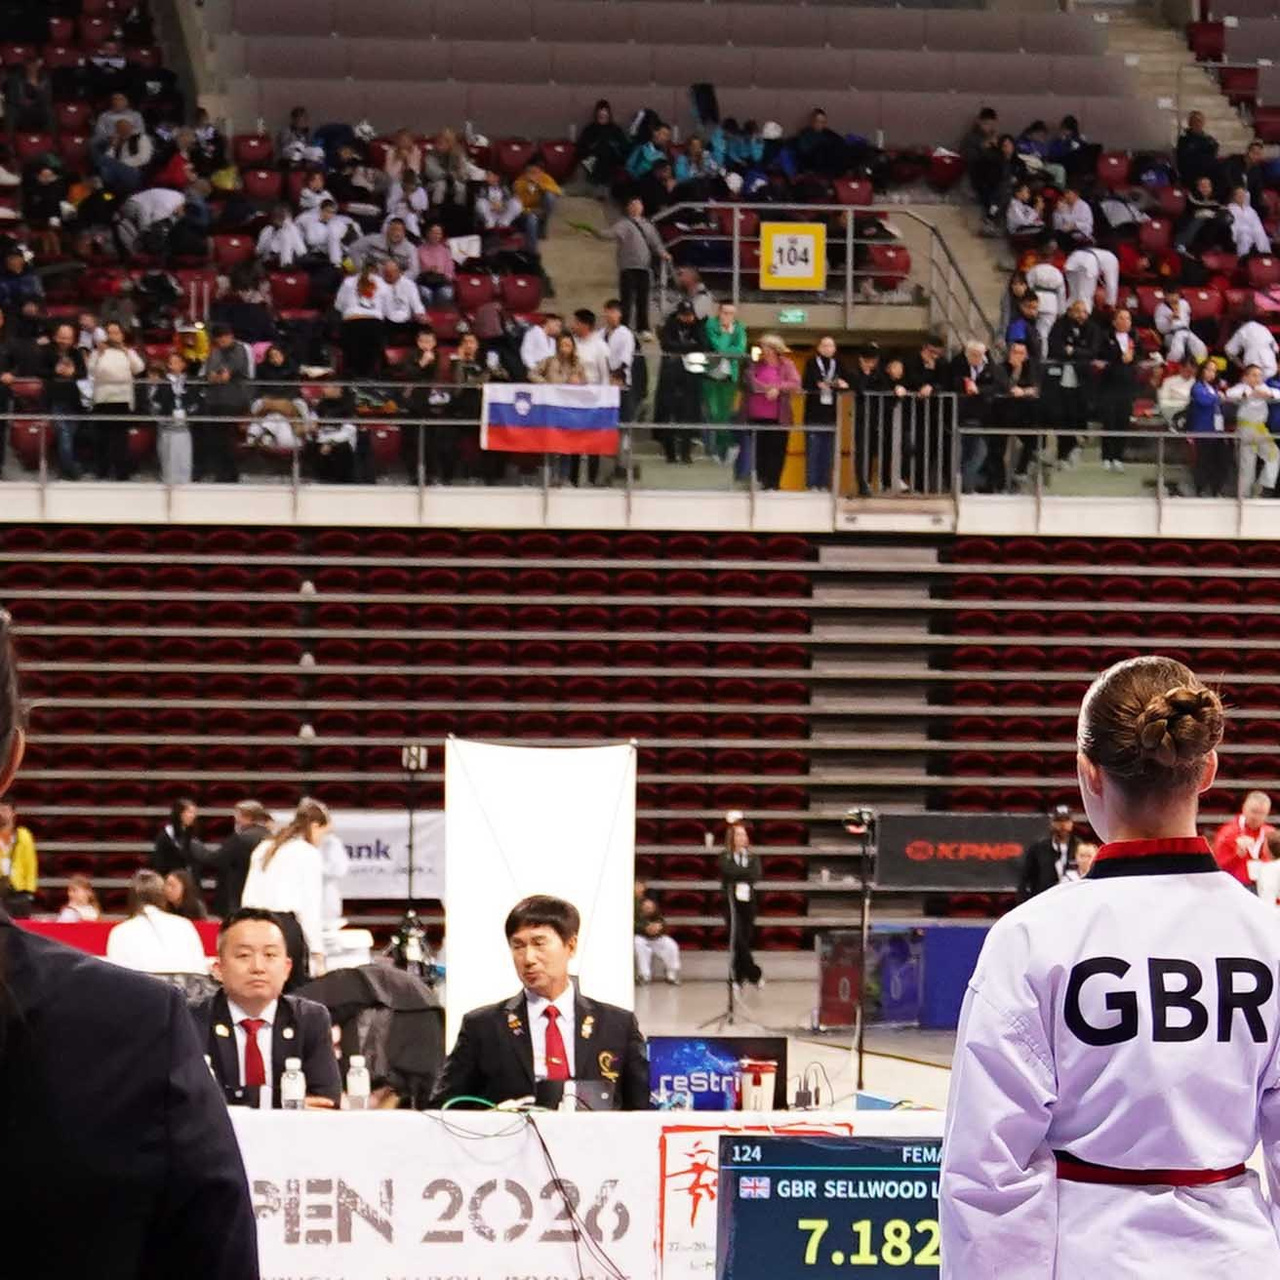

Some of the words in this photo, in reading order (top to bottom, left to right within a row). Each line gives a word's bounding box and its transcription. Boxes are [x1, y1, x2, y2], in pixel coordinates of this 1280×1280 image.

[776, 247, 809, 265] 104
[1064, 957, 1274, 1047] GBR
[732, 1145, 762, 1162] 124
[777, 1180, 817, 1198] GBR
[824, 1181, 927, 1198] SELLWOOD
[421, 1178, 631, 1243] 2026
[797, 1219, 942, 1266] 7.182
